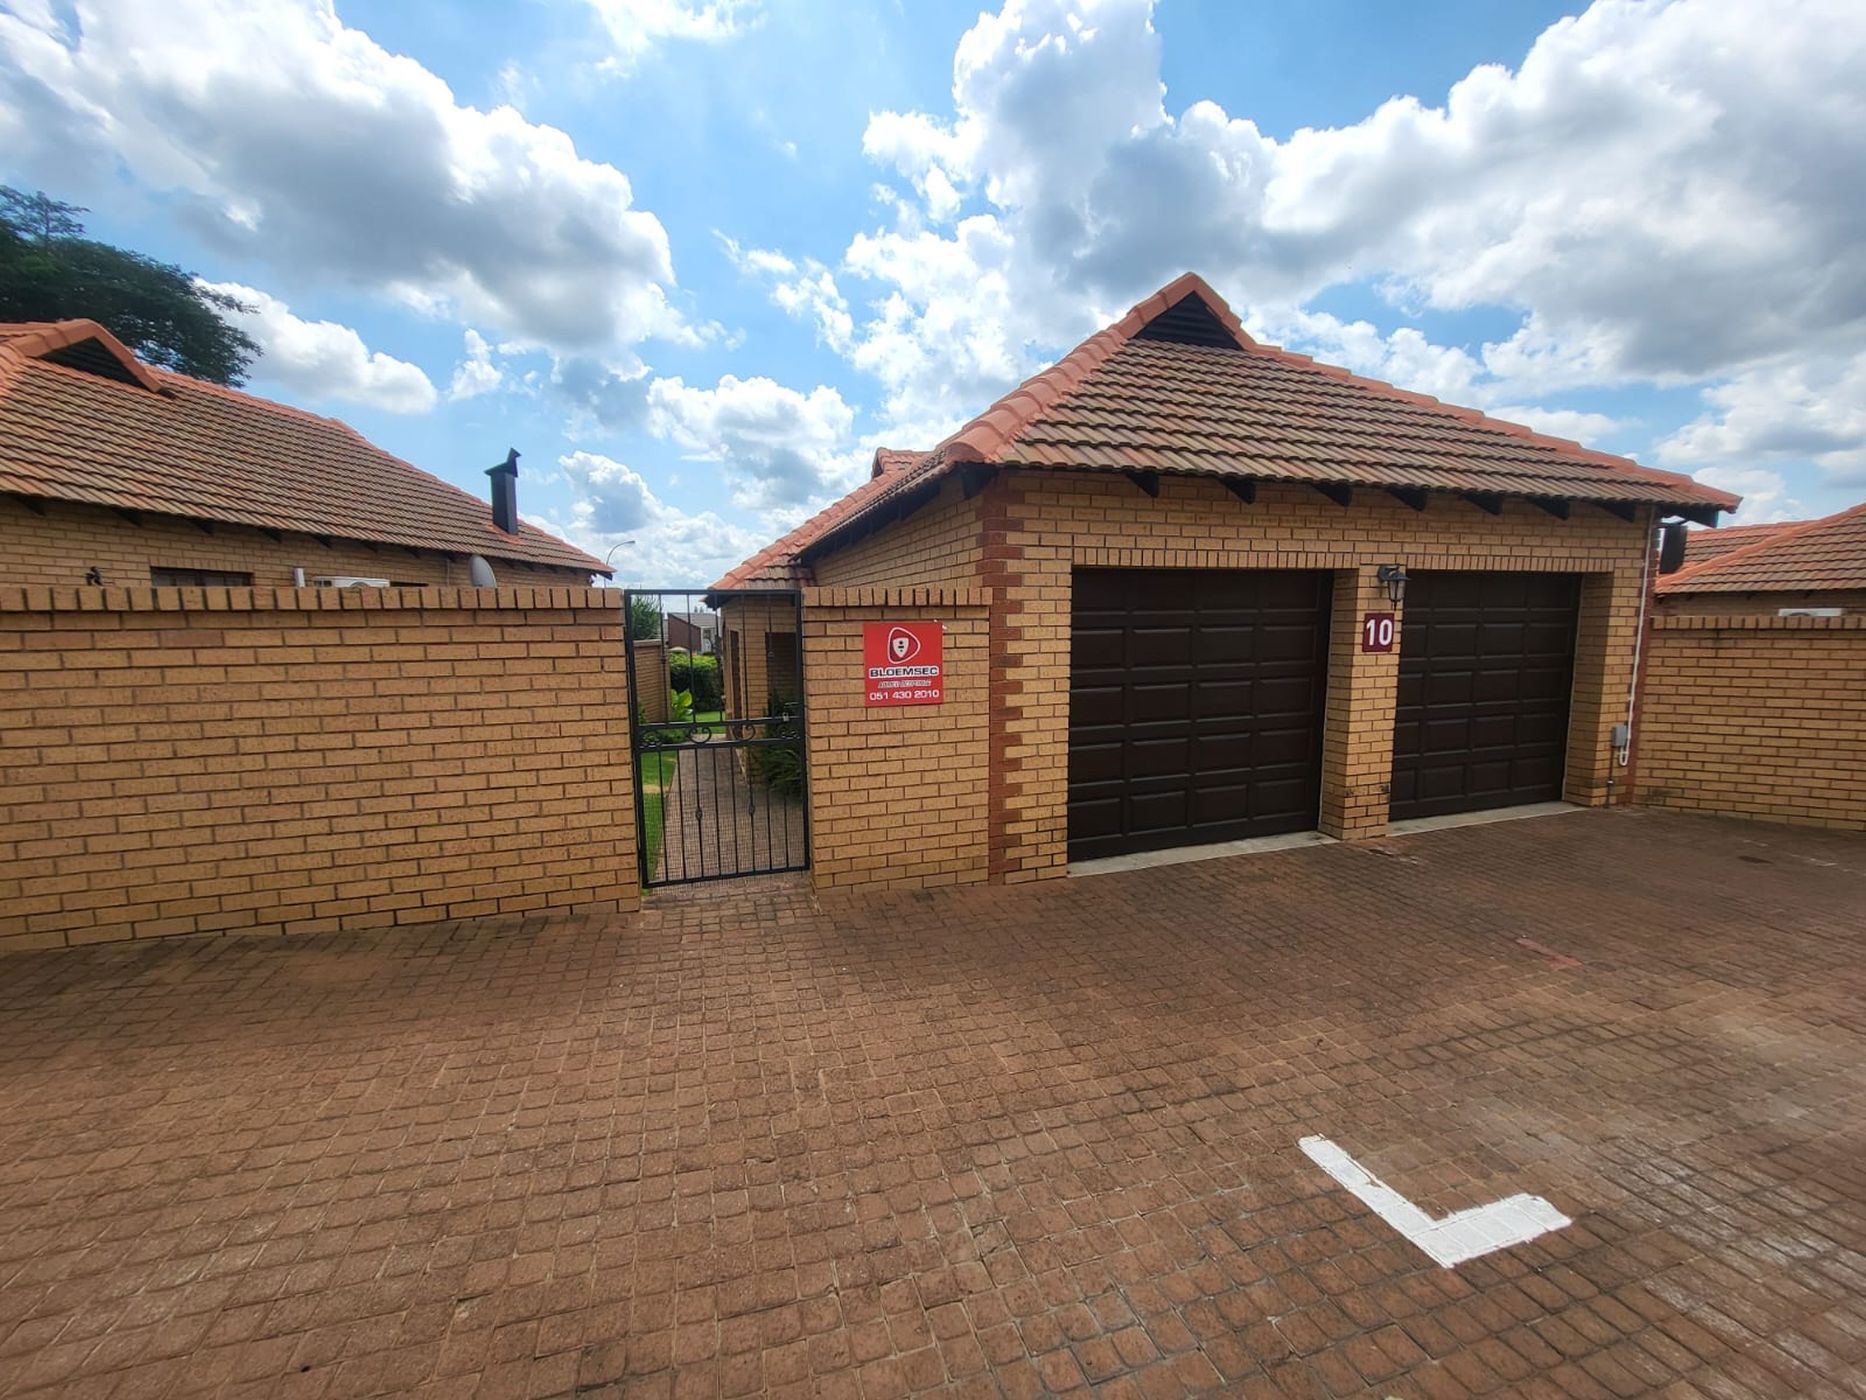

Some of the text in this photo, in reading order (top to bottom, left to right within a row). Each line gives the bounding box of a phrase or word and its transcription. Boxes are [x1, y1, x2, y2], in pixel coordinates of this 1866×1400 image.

[1366, 619, 1393, 646] 10
[869, 666, 939, 679] BLOEMSEC
[869, 692, 888, 700] 051
[914, 689, 939, 698] 2010
